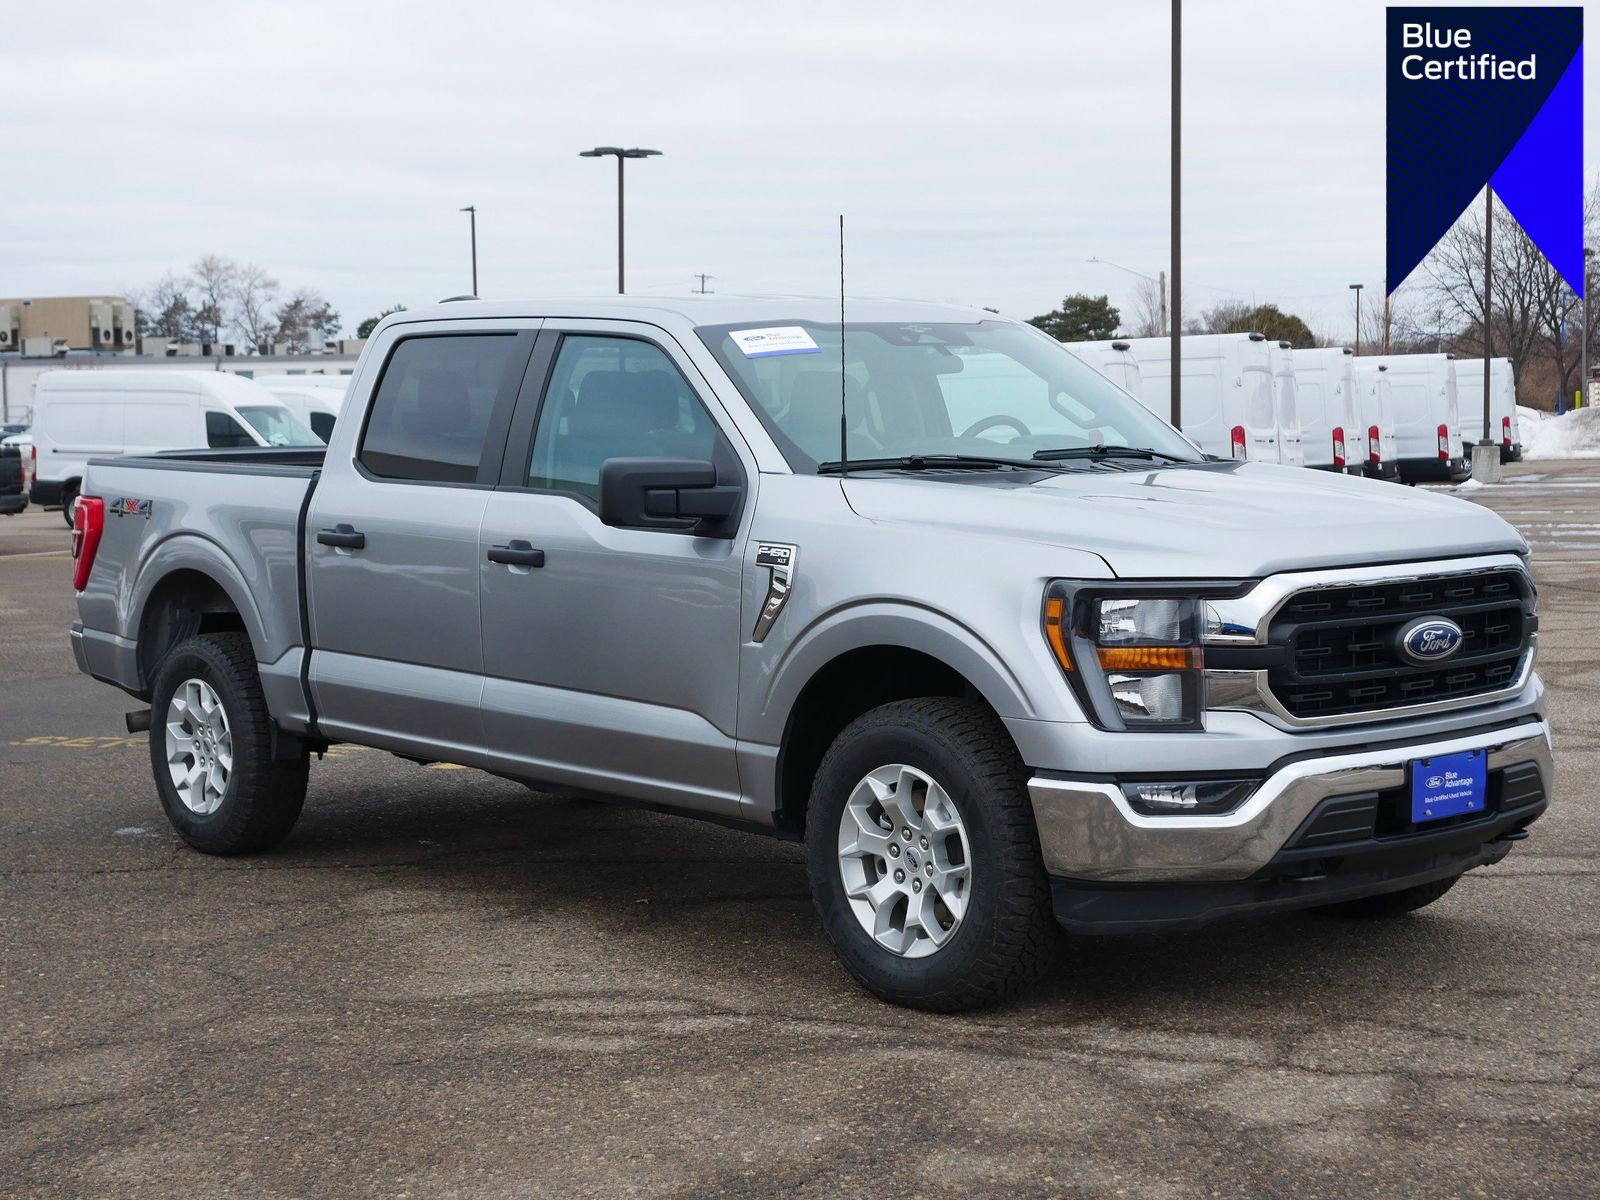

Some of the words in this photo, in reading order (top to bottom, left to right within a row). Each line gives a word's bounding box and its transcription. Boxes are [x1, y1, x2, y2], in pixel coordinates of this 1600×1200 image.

[758, 546, 790, 558] F-150
[1420, 629, 1451, 652] Ford
[1445, 772, 1457, 780] Blue
[1445, 778, 1473, 788] Advantage
